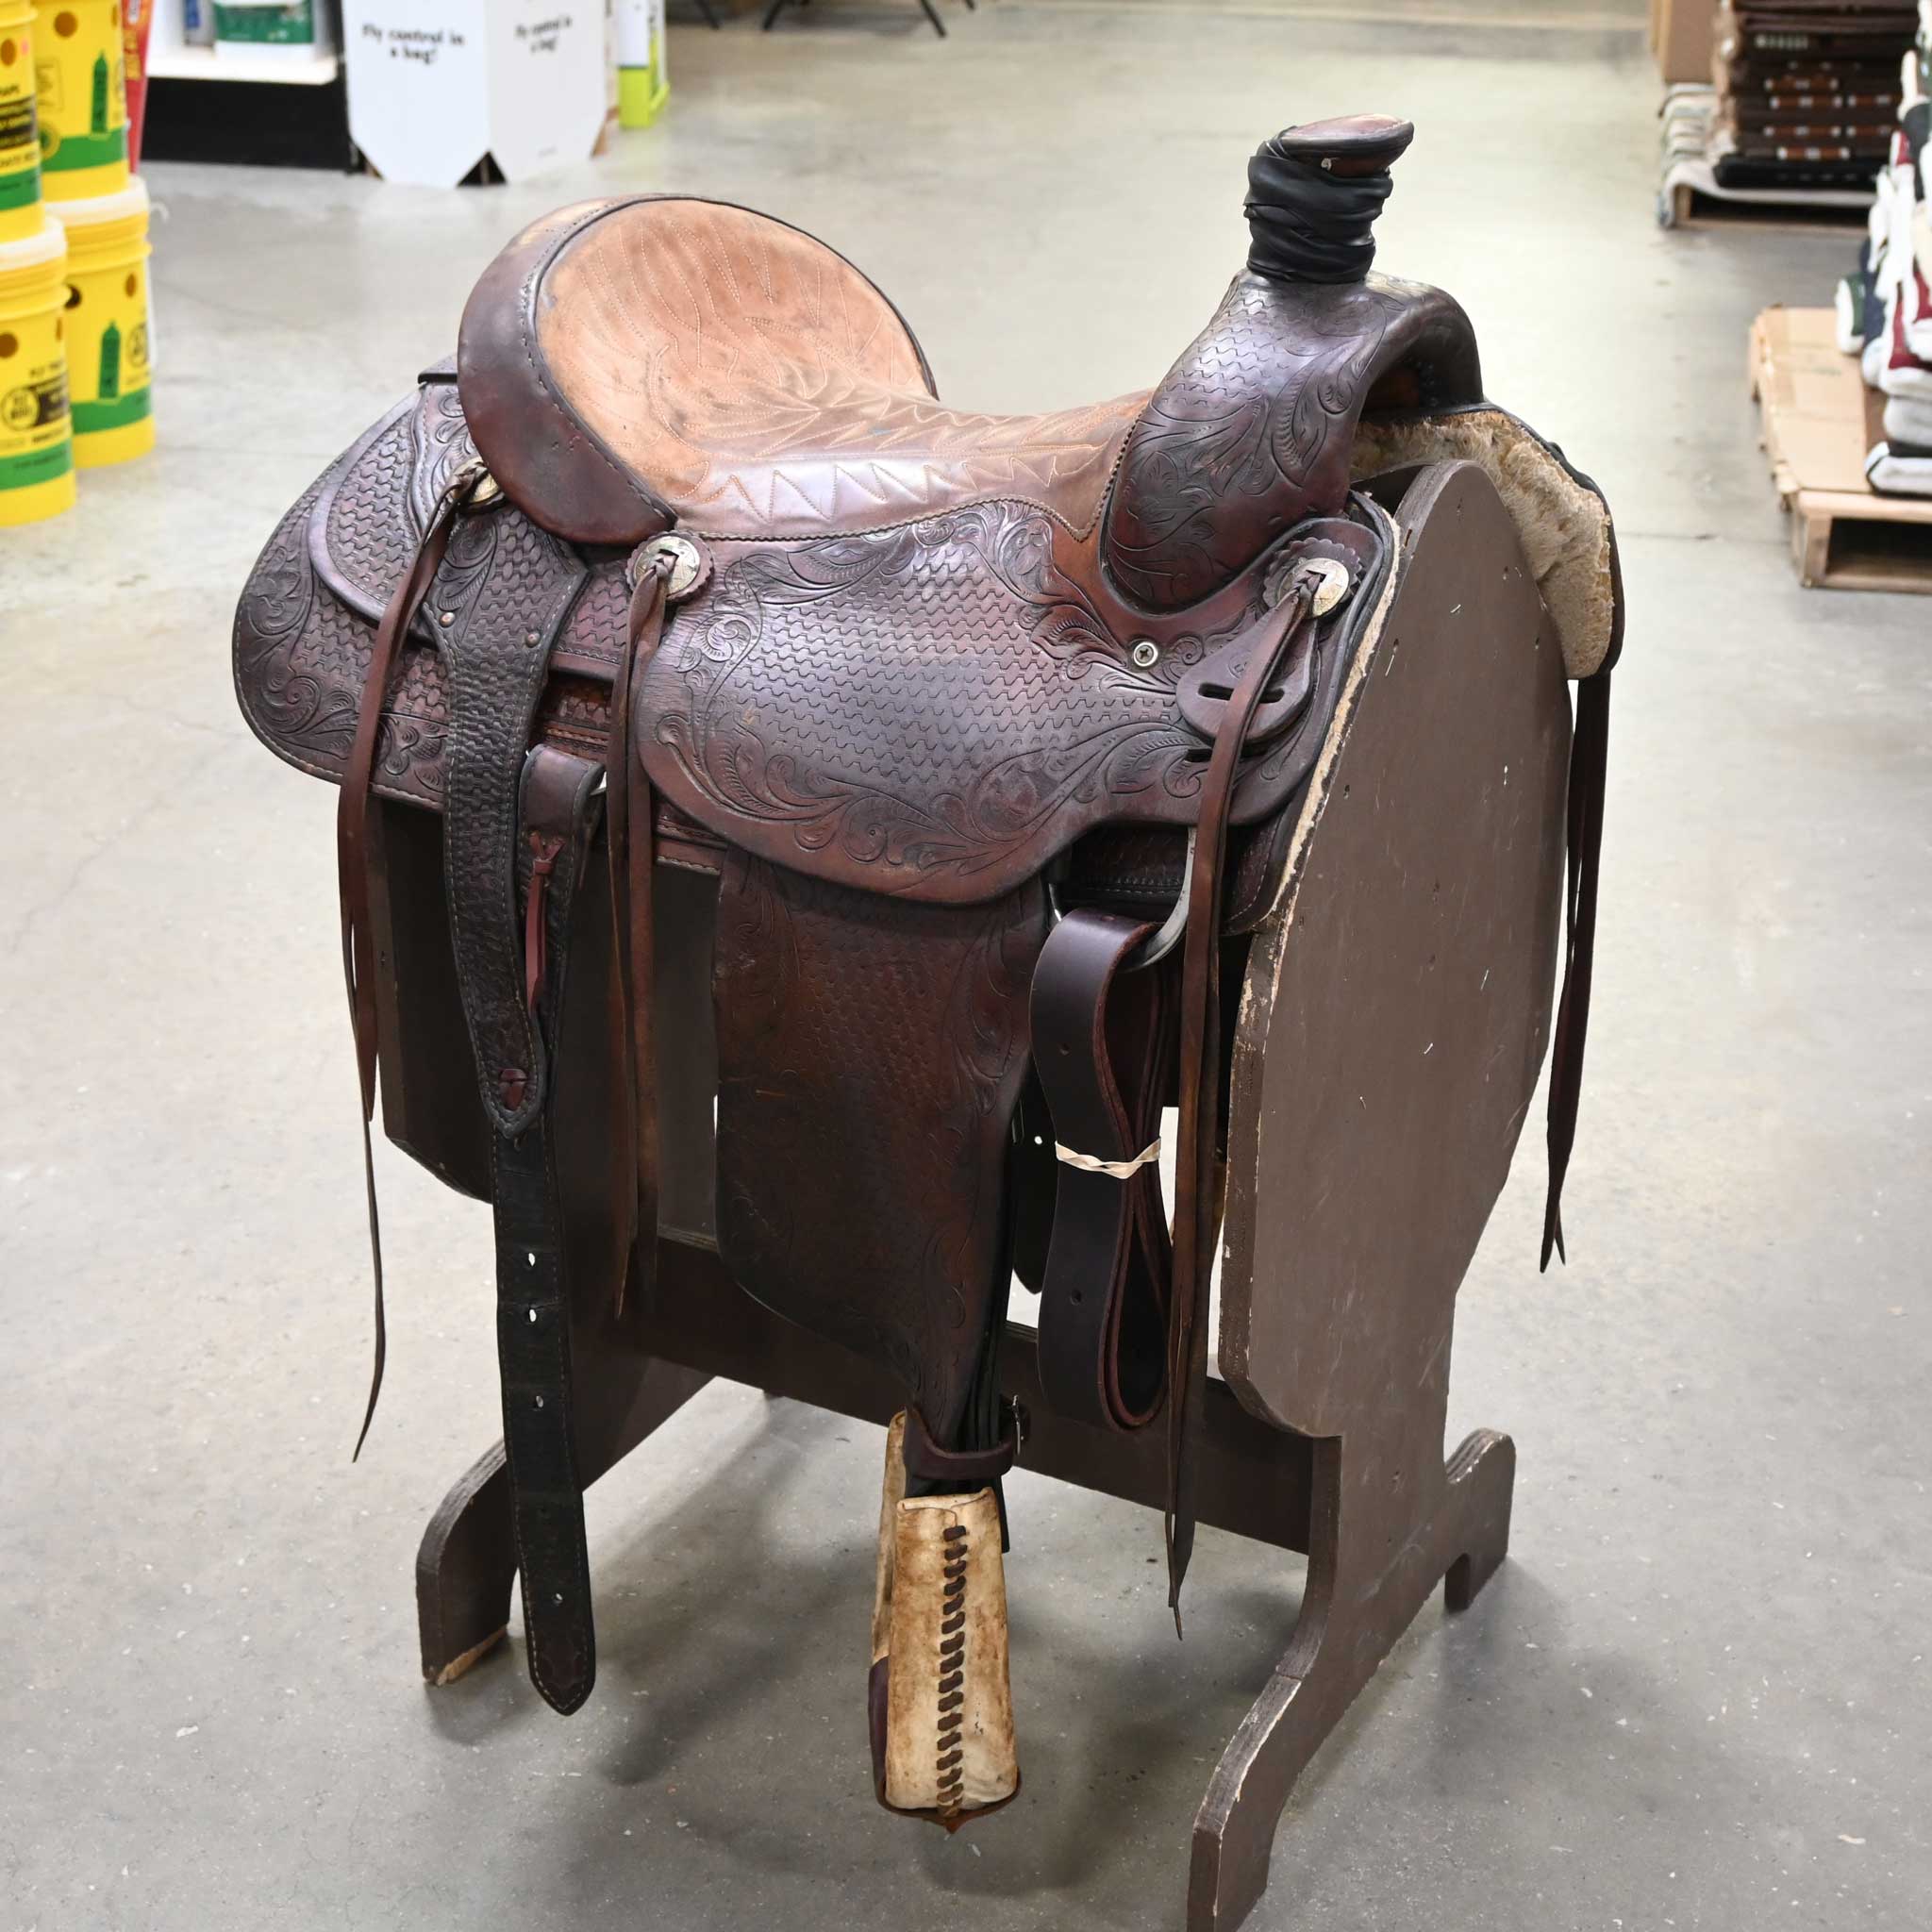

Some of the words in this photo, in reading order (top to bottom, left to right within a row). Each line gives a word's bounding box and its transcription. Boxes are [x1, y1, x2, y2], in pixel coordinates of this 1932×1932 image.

[362, 23, 382, 43] Fly
[389, 28, 443, 43] control
[390, 47, 397, 58] a
[403, 45, 437, 64] bag!
